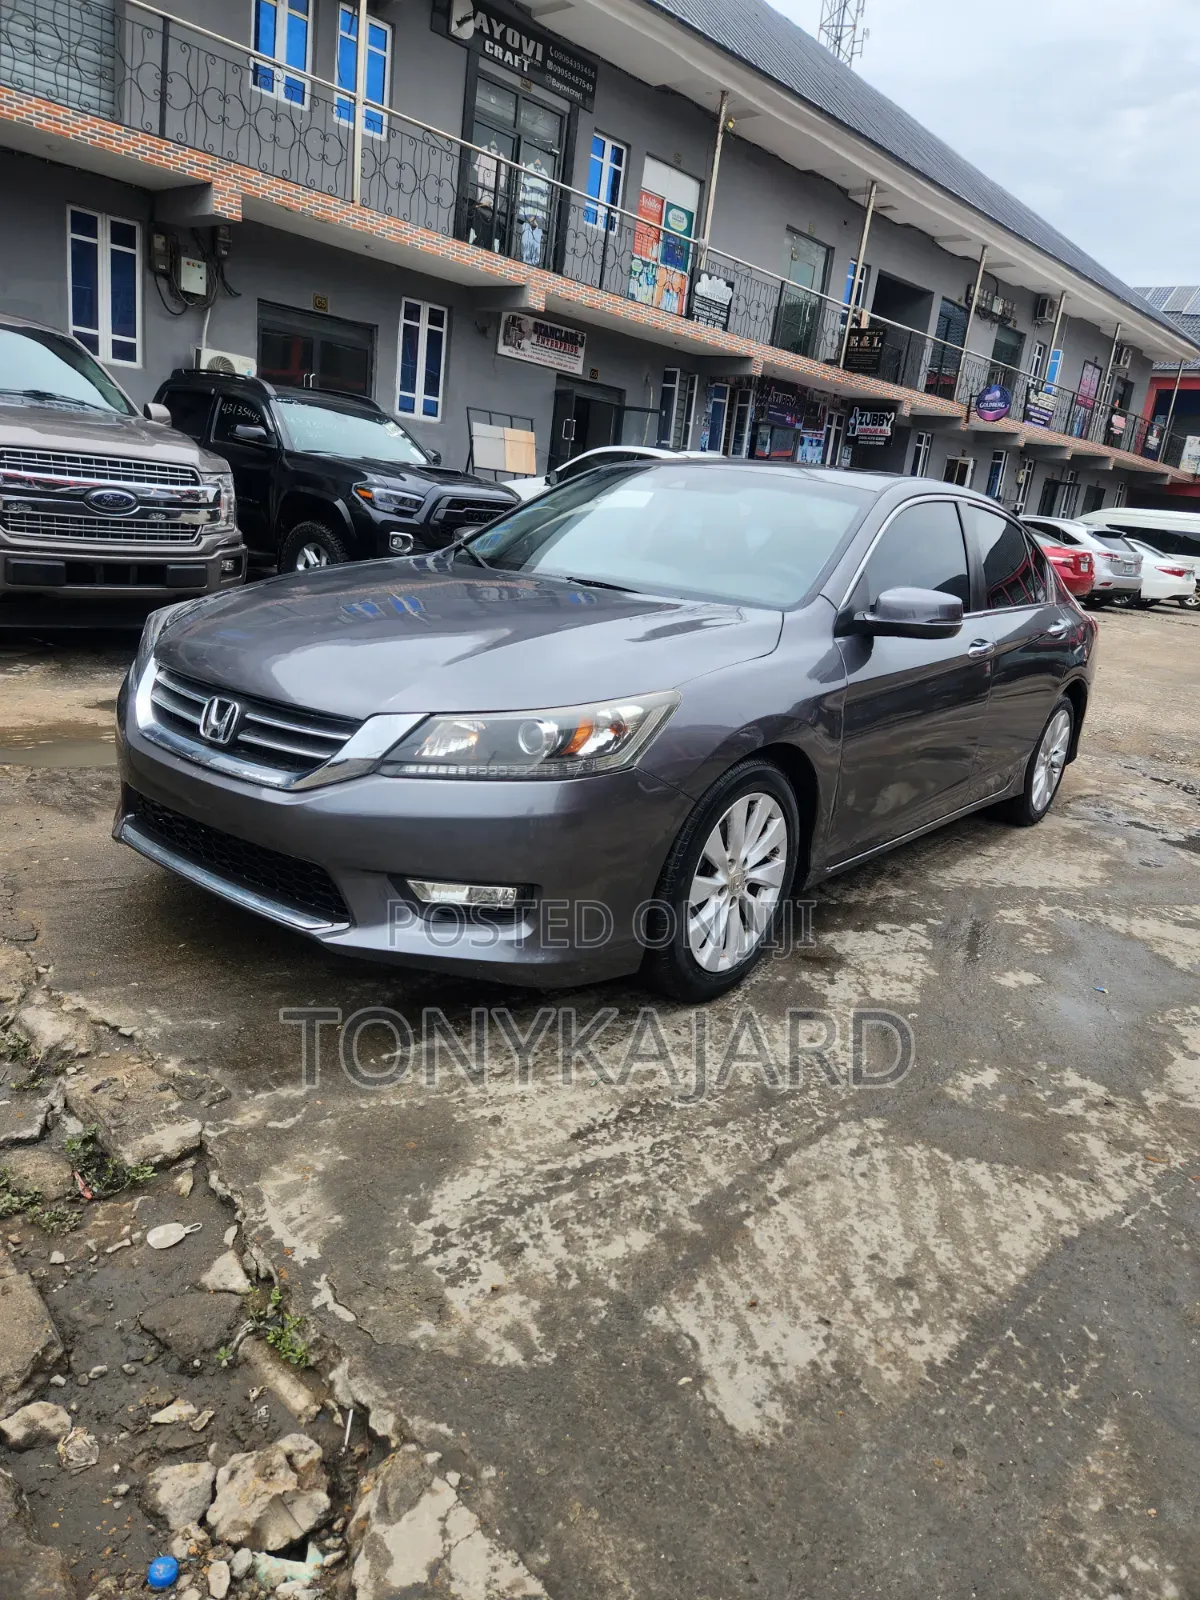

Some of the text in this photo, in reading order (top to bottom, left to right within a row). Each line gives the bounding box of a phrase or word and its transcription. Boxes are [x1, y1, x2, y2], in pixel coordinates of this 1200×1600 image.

[485, 39, 530, 72] CRAFT
[536, 335, 579, 354] ENTERPRISE
[848, 335, 882, 348] E & L
[980, 401, 1005, 409] GOLDBERG
[858, 411, 895, 428] ZUBBY
[102, 494, 126, 508] Ford
